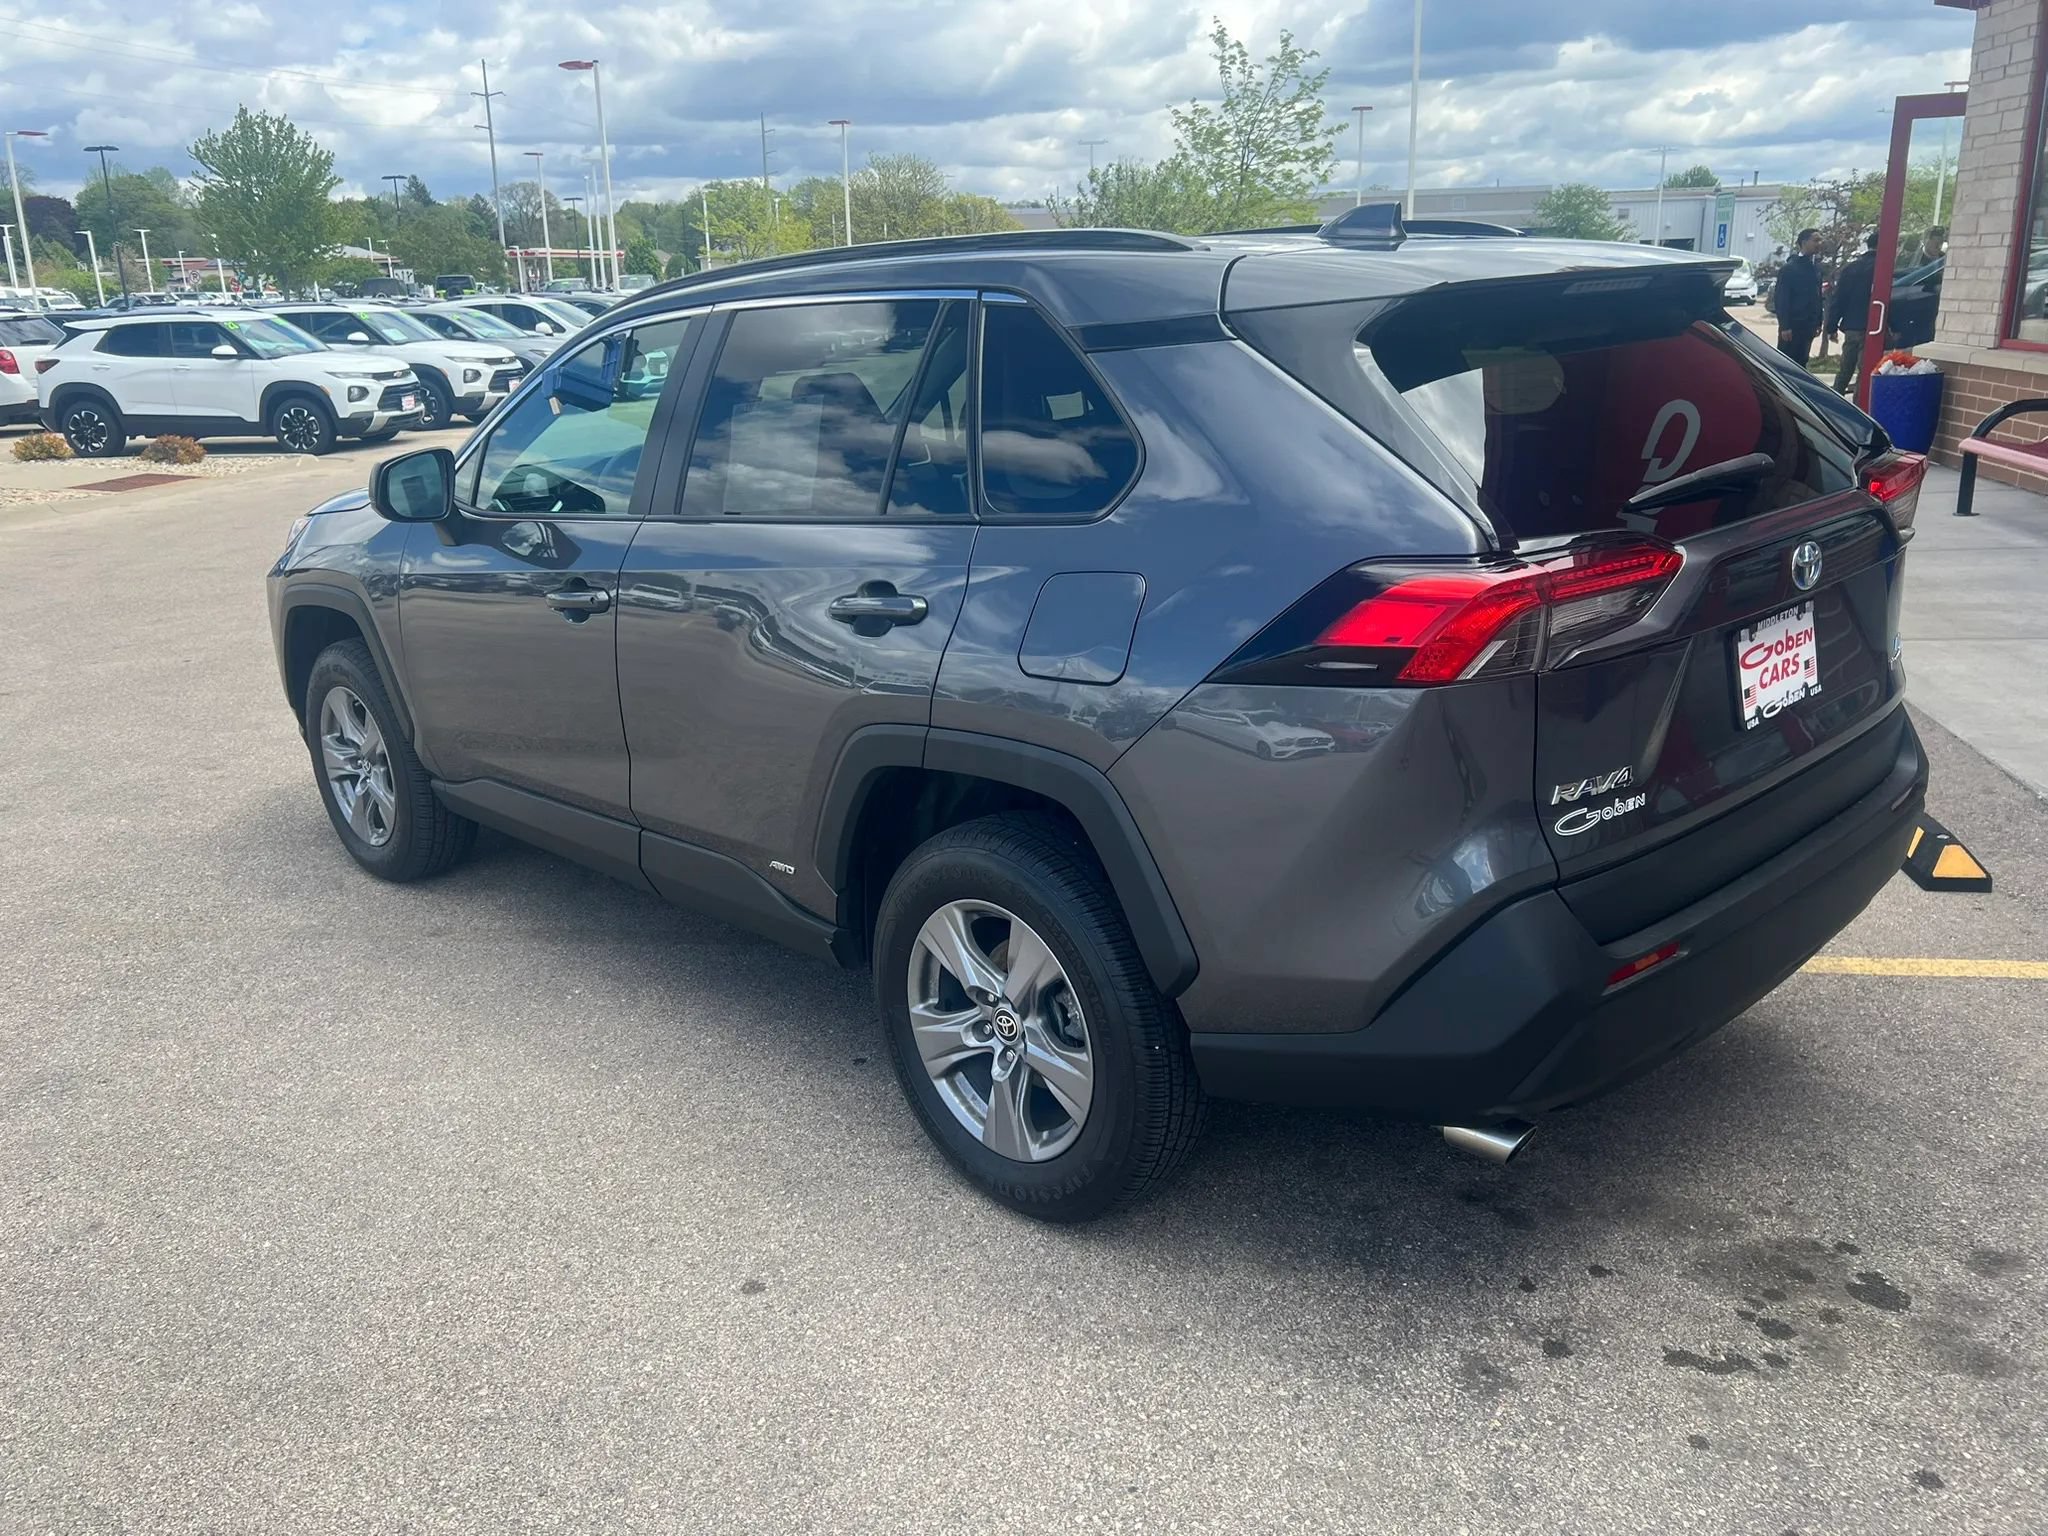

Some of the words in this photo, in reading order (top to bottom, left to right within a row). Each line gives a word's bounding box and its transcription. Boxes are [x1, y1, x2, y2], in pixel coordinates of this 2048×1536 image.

[1757, 606, 1800, 630] MIDDLETON
[1759, 652, 1800, 690] CARS
[1810, 684, 1822, 696] USA
[1747, 717, 1760, 730] USA
[1551, 765, 1634, 806] RAV4
